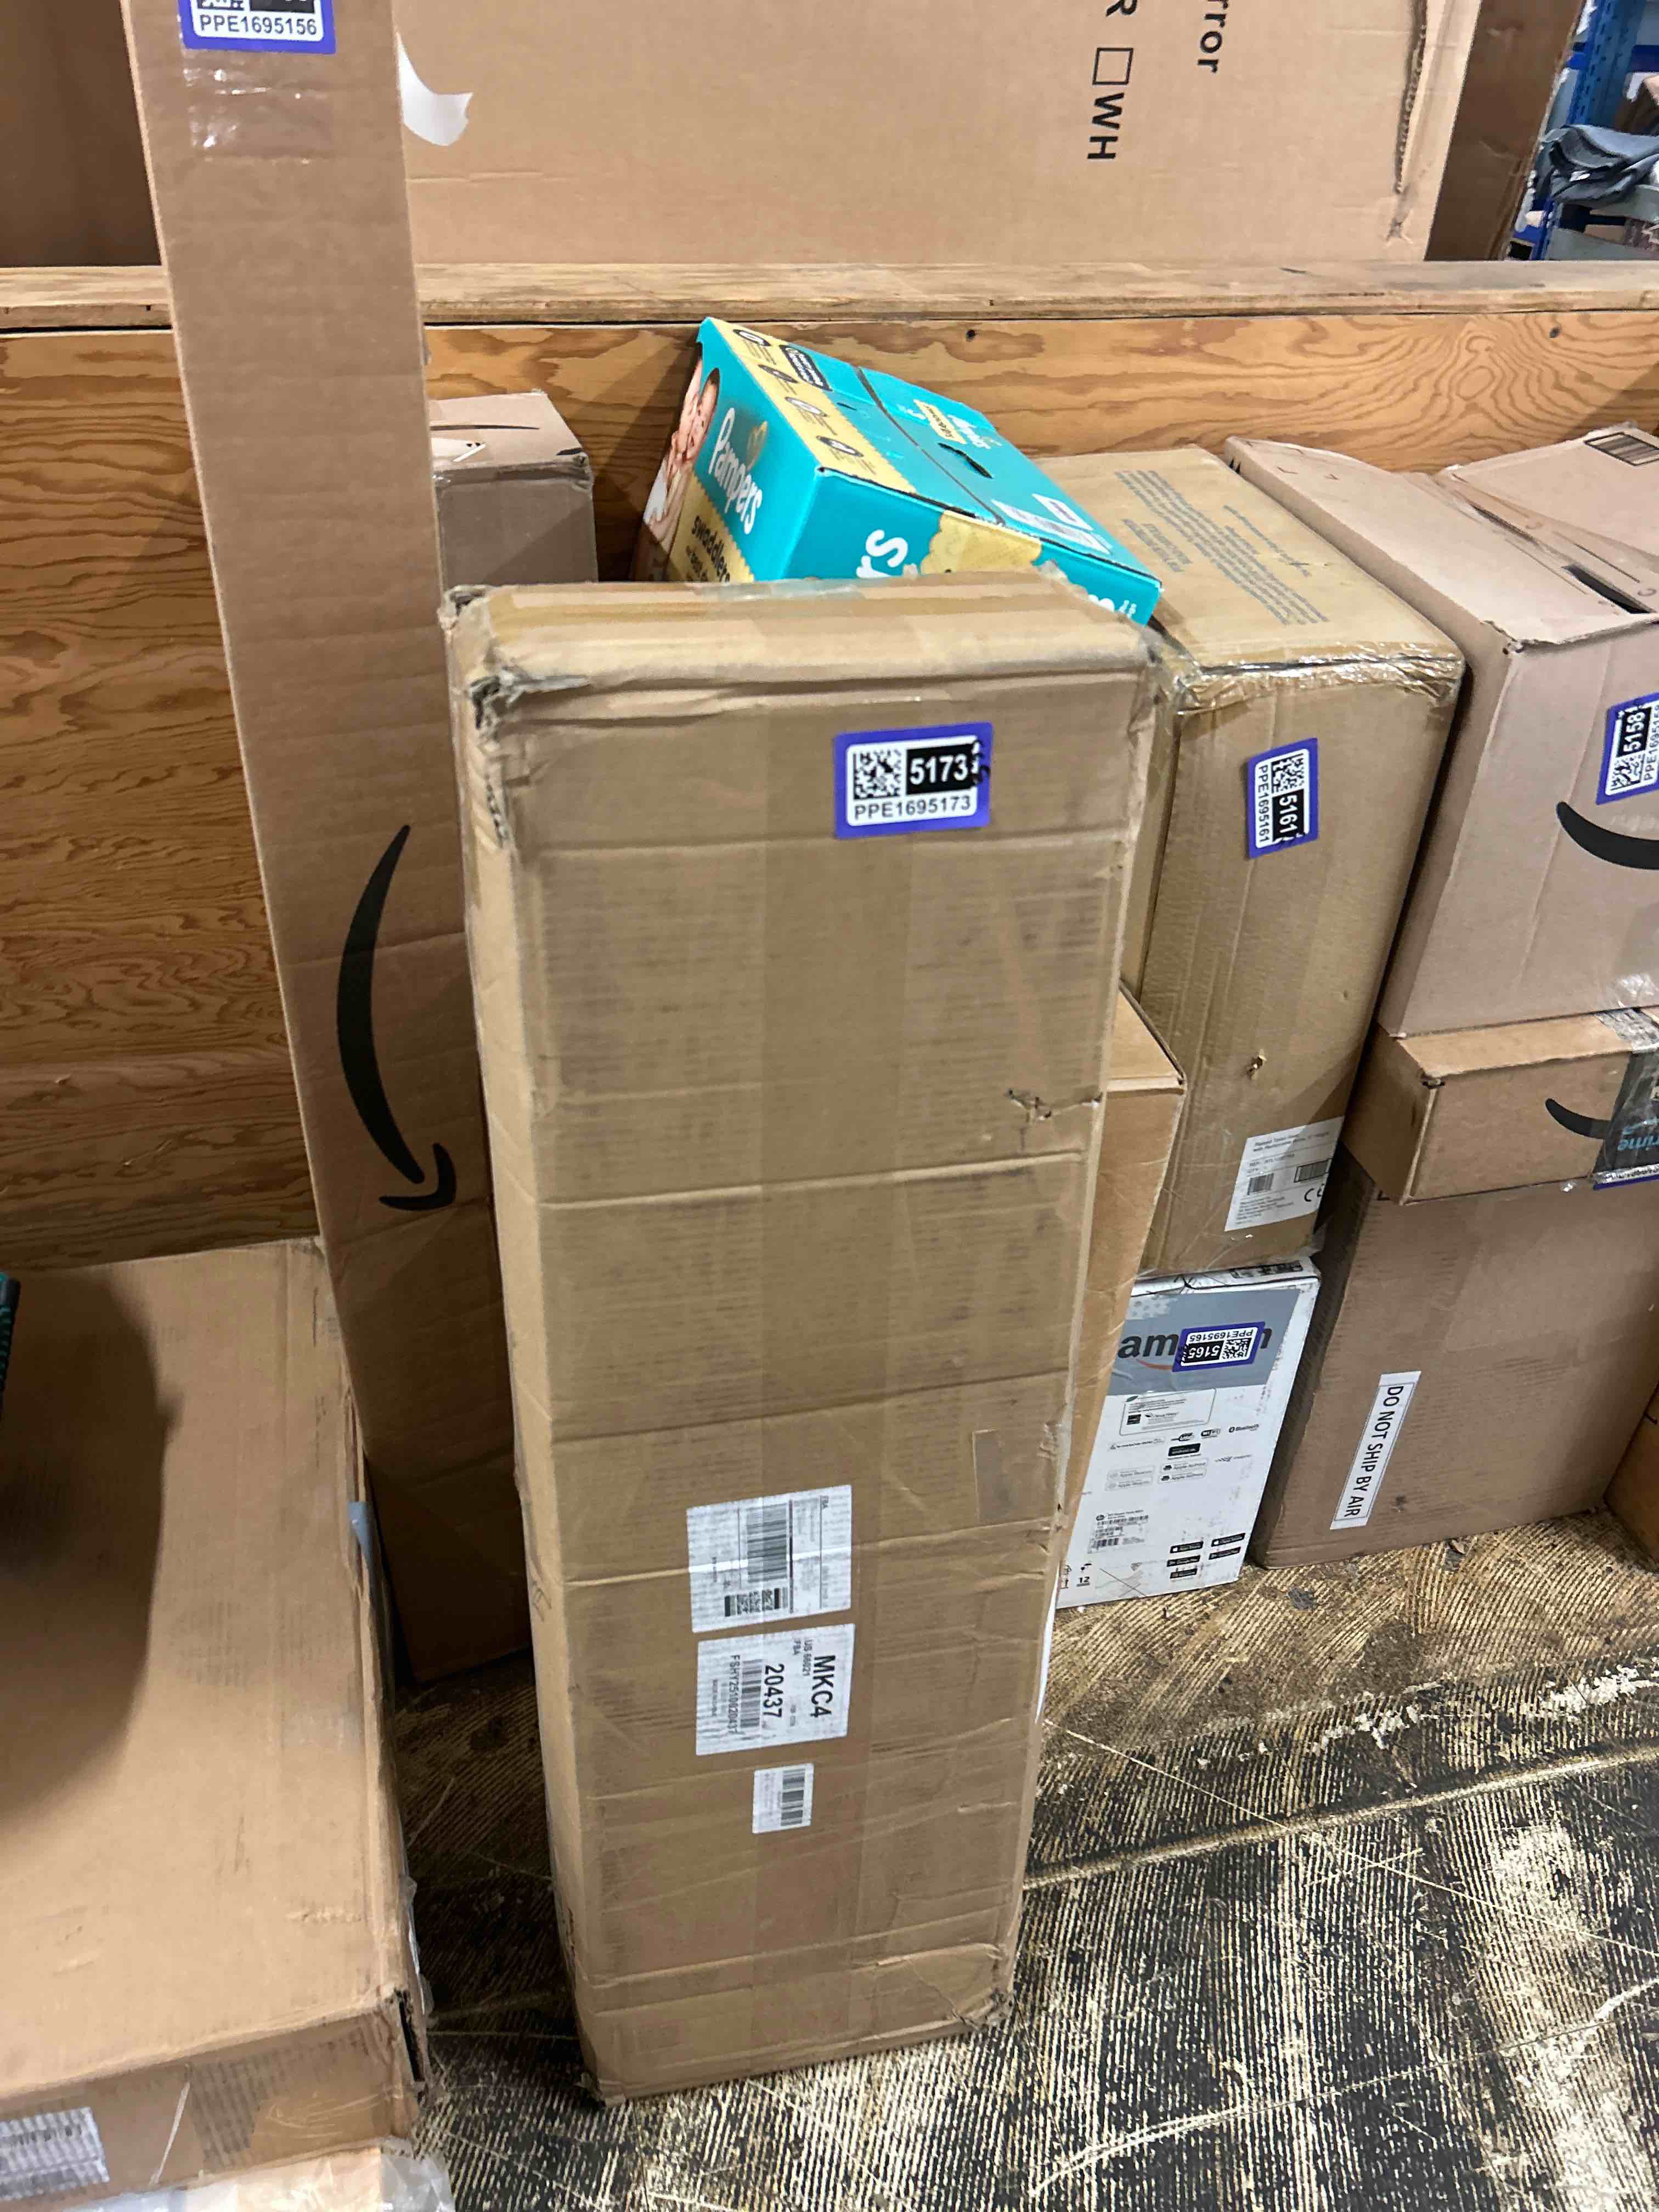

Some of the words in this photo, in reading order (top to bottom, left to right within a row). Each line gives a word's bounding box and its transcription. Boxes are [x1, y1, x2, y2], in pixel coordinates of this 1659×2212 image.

[200, 14, 317, 35] PPE1695156
[1087, 92, 1125, 159] WH
[708, 408, 763, 535] Pampers
[692, 515, 730, 582] swaddler
[1623, 712, 1646, 752] 5158
[909, 754, 969, 785] 5173
[854, 795, 970, 820] PPE1695173
[1258, 765, 1270, 842] PPE1695161
[1279, 795, 1298, 833] 5161
[1189, 1329, 1253, 1343] PPE1695165
[1188, 1345, 1221, 1359] 5165
[1383, 1385, 1404, 1407] DO
[1372, 1410, 1395, 1440] NOT
[1361, 1443, 1383, 1472] SHIP
[1353, 1476, 1372, 1491] BY
[1344, 1496, 1364, 1517] AIR
[763, 1662, 785, 1718] 20437
[810, 1655, 836, 1718] MKC4
